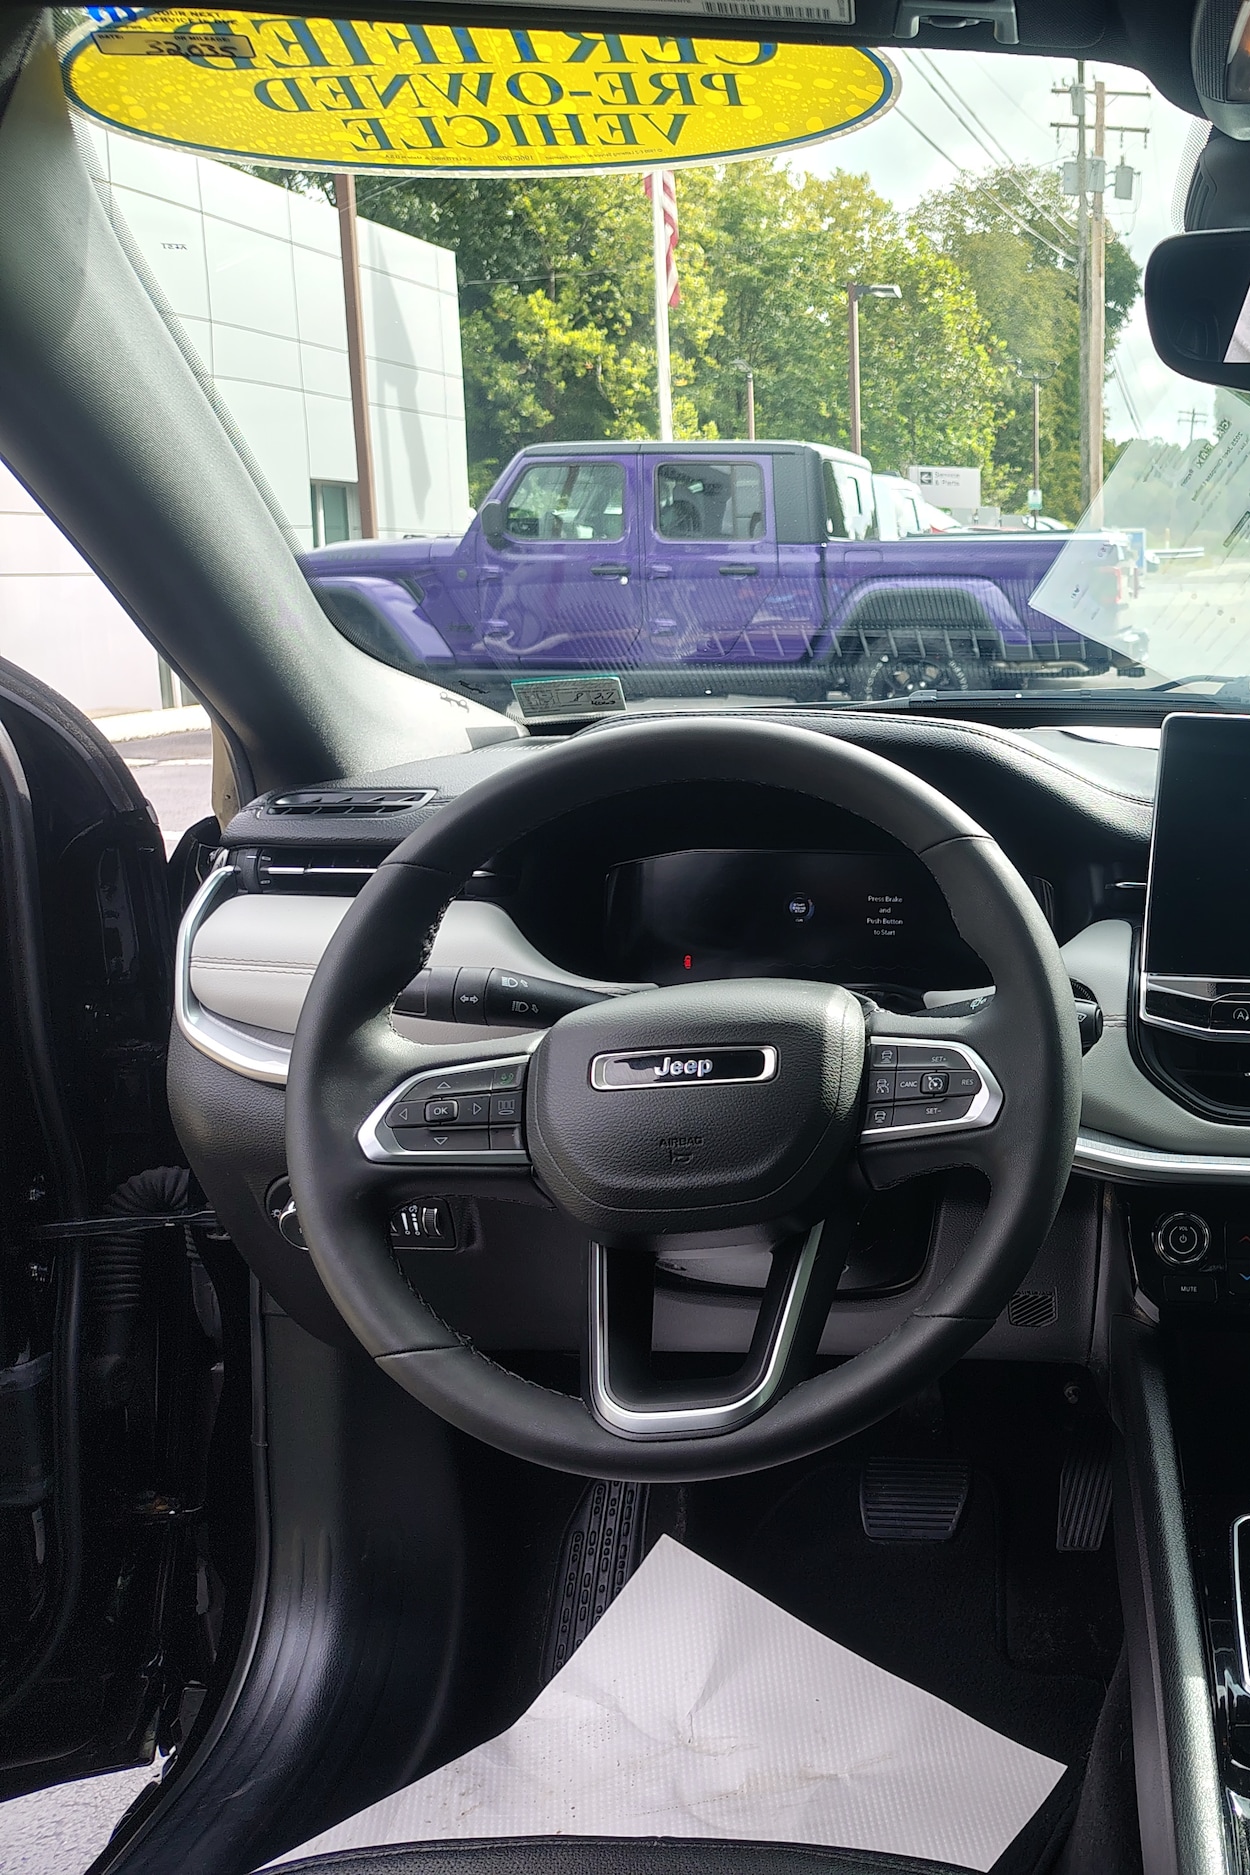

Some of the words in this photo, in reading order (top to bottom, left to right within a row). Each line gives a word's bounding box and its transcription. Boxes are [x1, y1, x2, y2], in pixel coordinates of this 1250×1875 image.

[867, 895, 884, 903] Press
[885, 895, 903, 903] Brake
[866, 917, 882, 925] Push
[654, 1056, 714, 1078] Jeep
[961, 1078, 974, 1086] RES
[433, 1106, 449, 1116] OK
[660, 1136, 705, 1148] AIRBAG
[1180, 1285, 1198, 1293] MUTE
